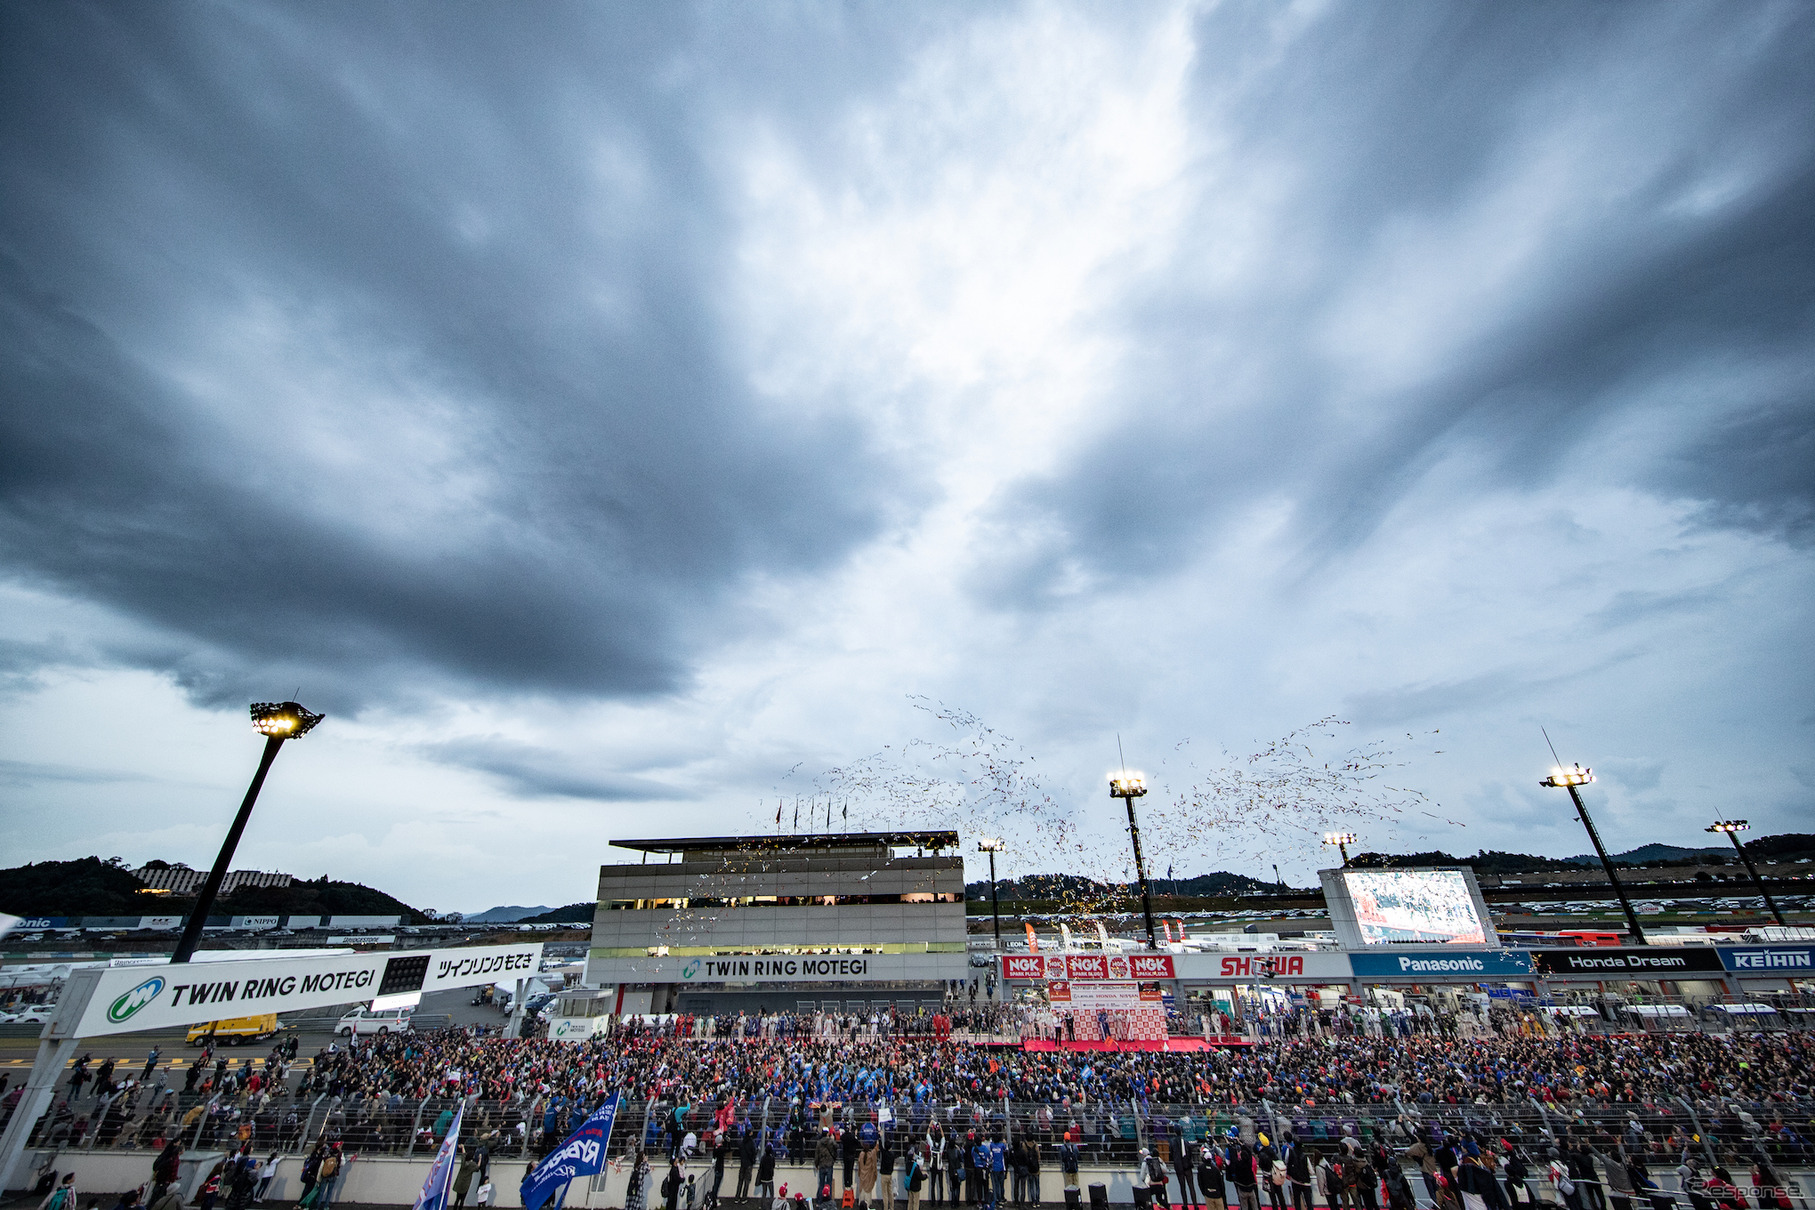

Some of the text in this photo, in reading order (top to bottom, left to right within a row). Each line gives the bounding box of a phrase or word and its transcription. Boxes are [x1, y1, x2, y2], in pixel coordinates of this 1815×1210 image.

[437, 953, 534, 979] ツインリングもてぎ
[1009, 958, 1040, 971] NGK
[1072, 958, 1102, 971] NGK
[1135, 958, 1167, 971] NGK
[1220, 956, 1303, 976] SHOWA
[1398, 956, 1484, 972] Panasonic
[1568, 955, 1686, 968] Honda Dream
[1732, 950, 1811, 968] KEIHIN
[706, 960, 867, 976] TWIN RING MOTEGI
[171, 970, 376, 1007] TWIN RING MOTEGI
